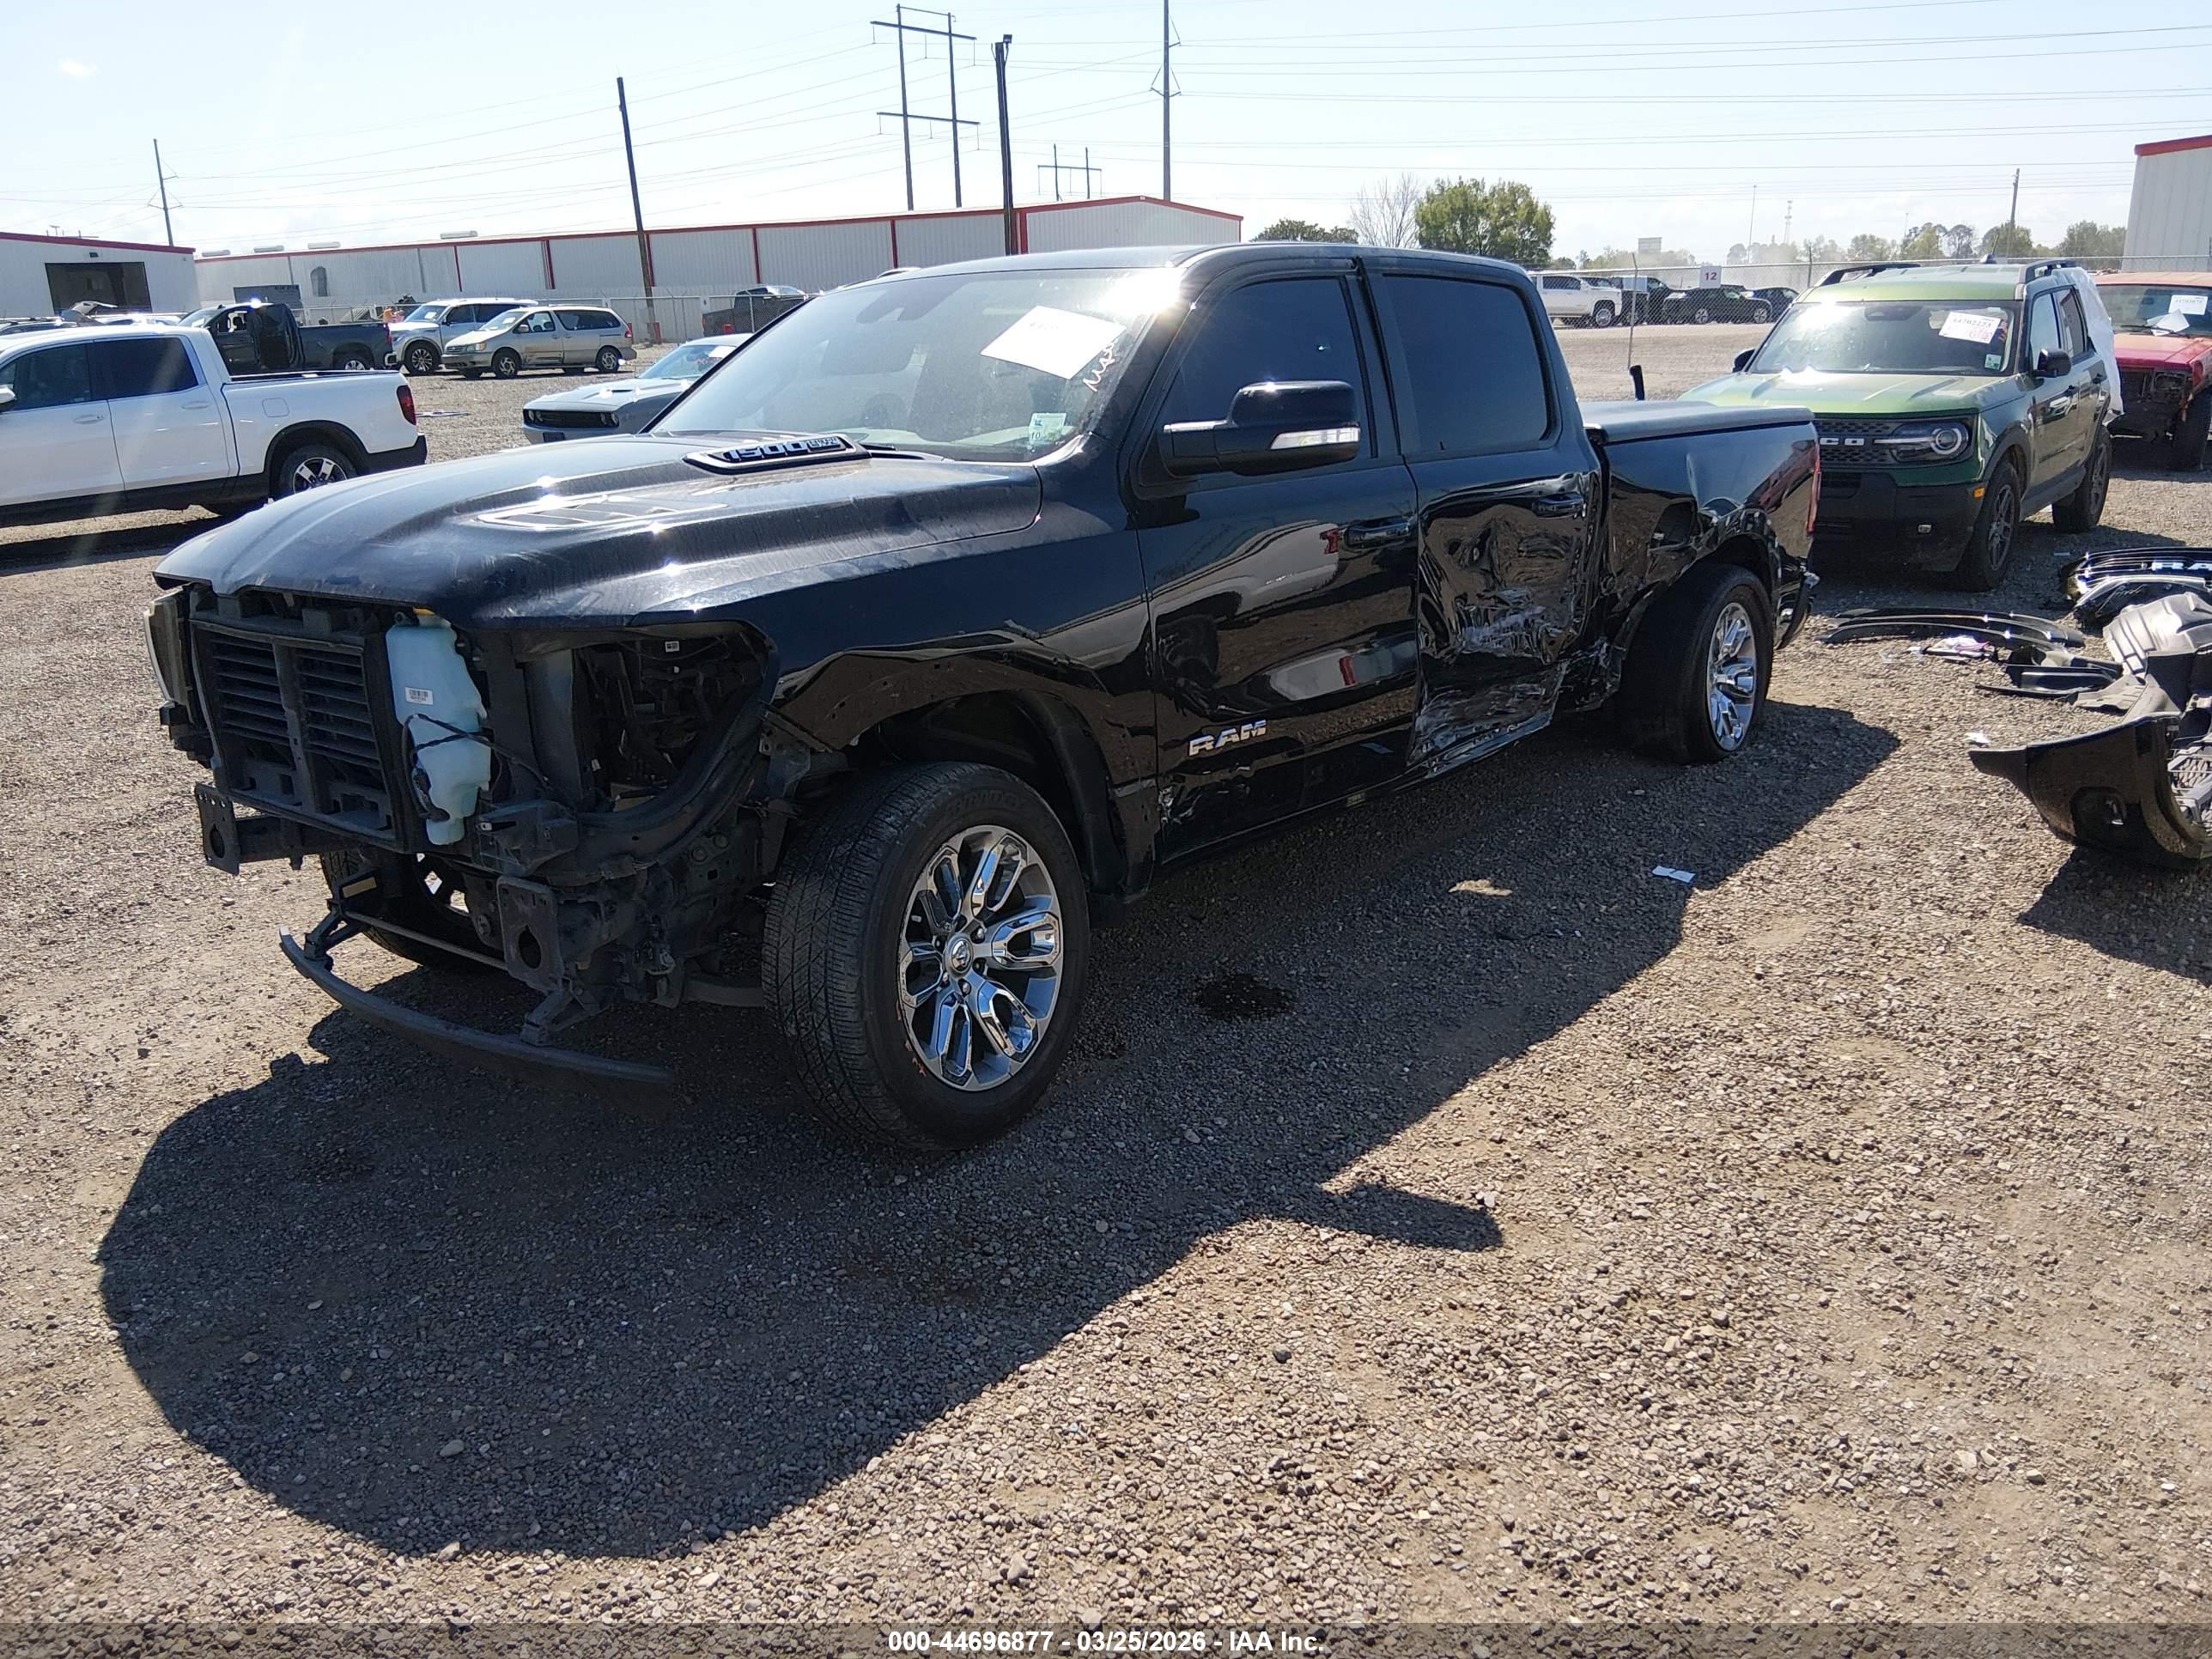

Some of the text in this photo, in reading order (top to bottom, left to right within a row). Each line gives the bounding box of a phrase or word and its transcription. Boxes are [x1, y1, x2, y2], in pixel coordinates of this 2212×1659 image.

[1704, 271, 1717, 281] 12
[729, 441, 809, 460] 1500
[1188, 719, 1267, 757] RAM
